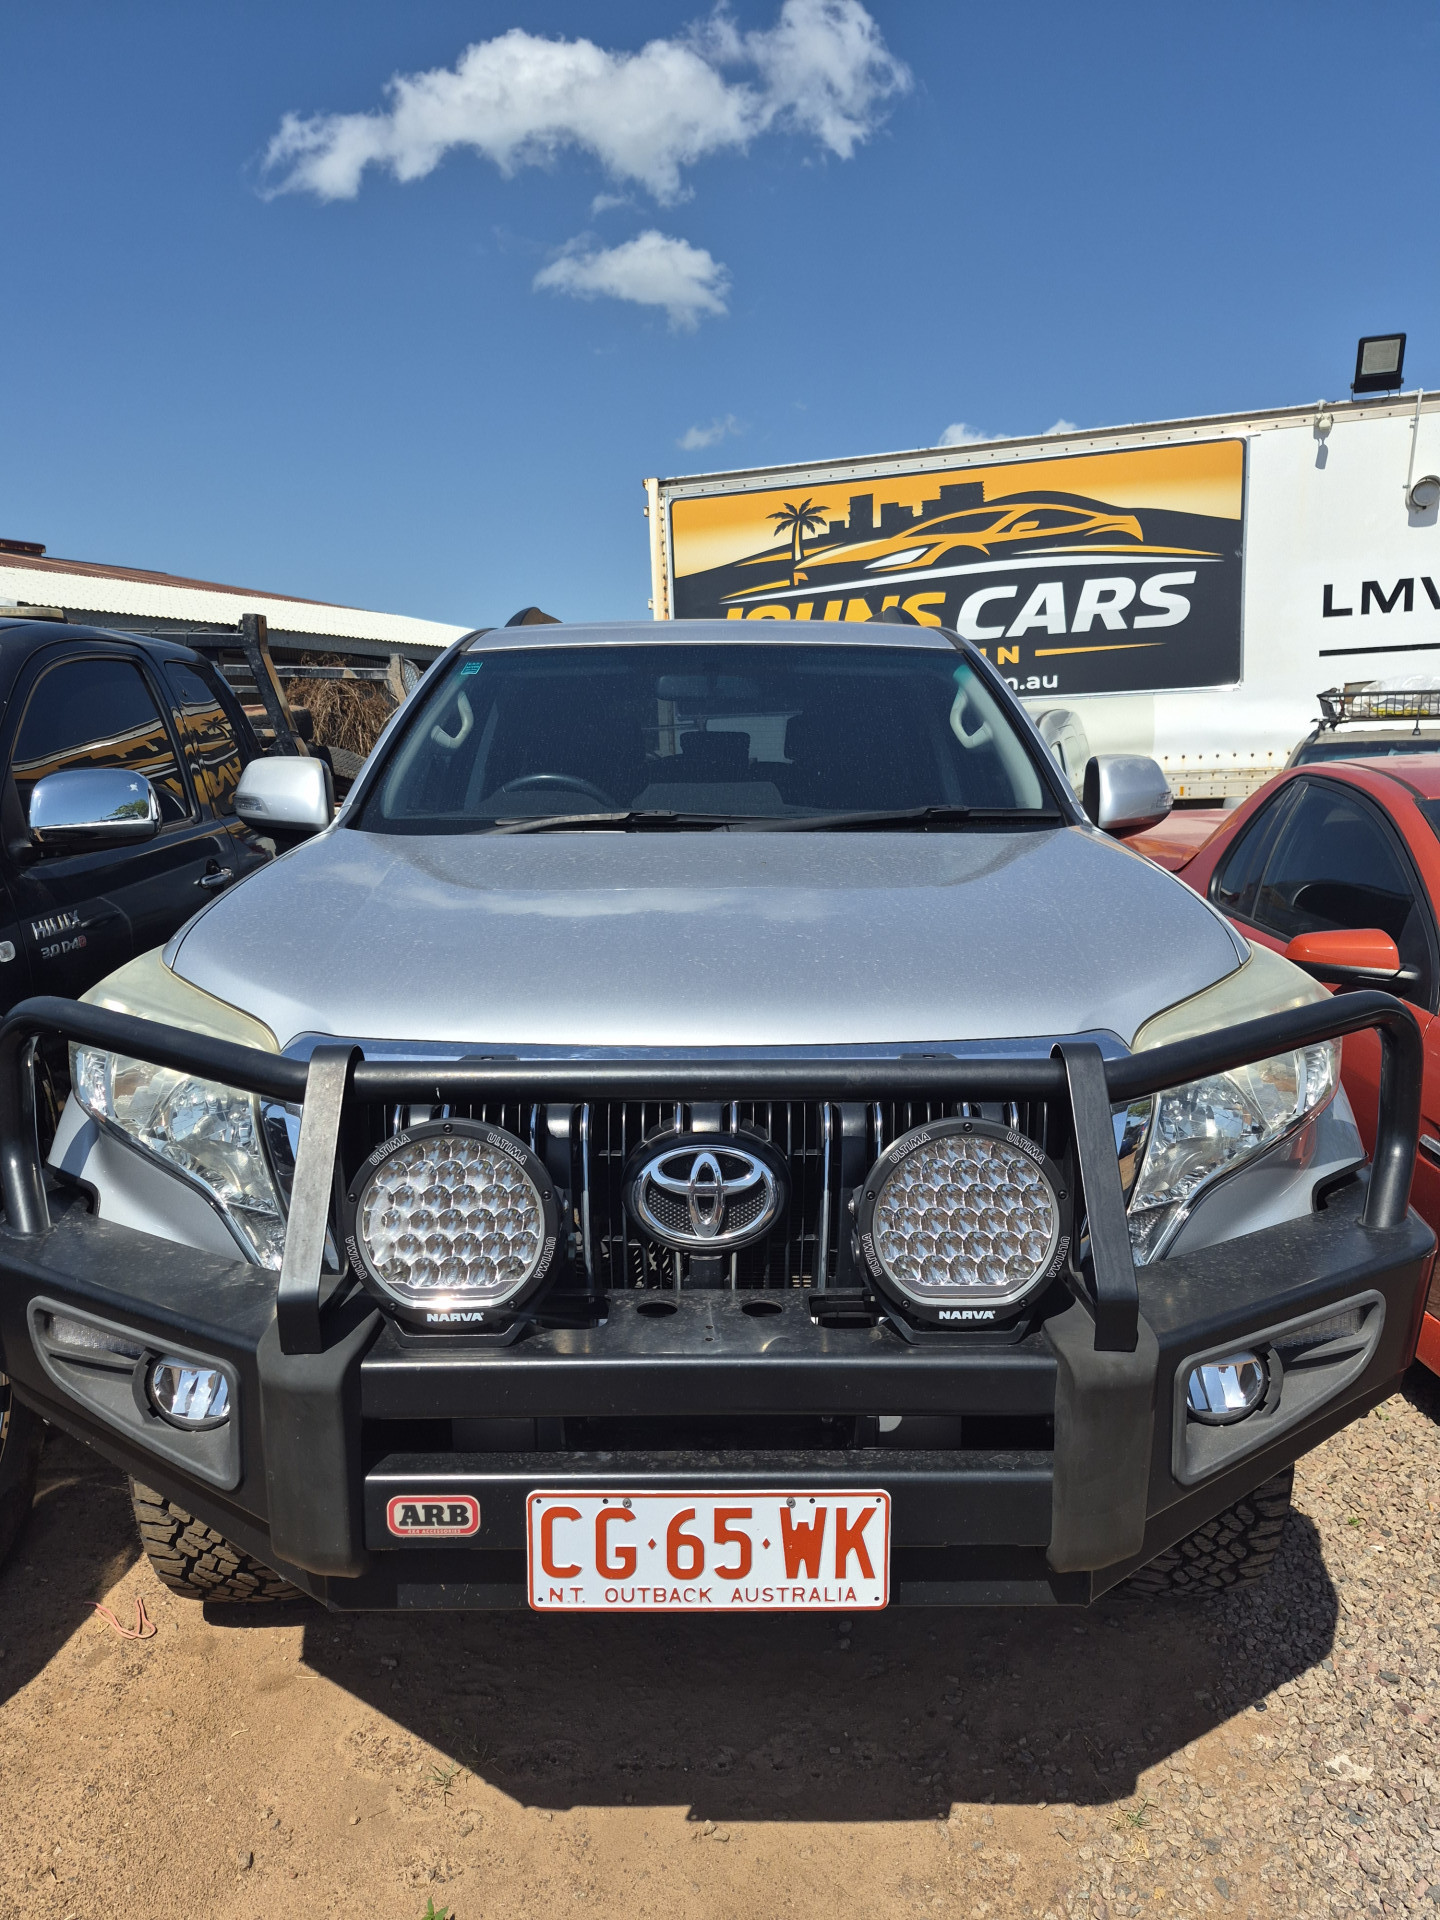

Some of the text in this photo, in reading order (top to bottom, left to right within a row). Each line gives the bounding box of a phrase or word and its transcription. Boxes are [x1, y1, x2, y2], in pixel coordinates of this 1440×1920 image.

[956, 571, 1197, 641] CARS
[31, 909, 80, 940] HILUX
[369, 1133, 411, 1166] ULTIMA
[486, 1132, 528, 1165] ULTIMA
[889, 1132, 931, 1163] ULTIMA
[1006, 1131, 1045, 1165] ULTIMA
[345, 1235, 368, 1280] ULTIMA
[533, 1236, 557, 1280] ULTIMA
[862, 1232, 883, 1277] ULTIMA
[1046, 1236, 1070, 1279] ULTIMA
[399, 1504, 469, 1526] ARB
[604, 1586, 713, 1603] OUTBACK
[731, 1586, 858, 1603] AUSTRALIA
